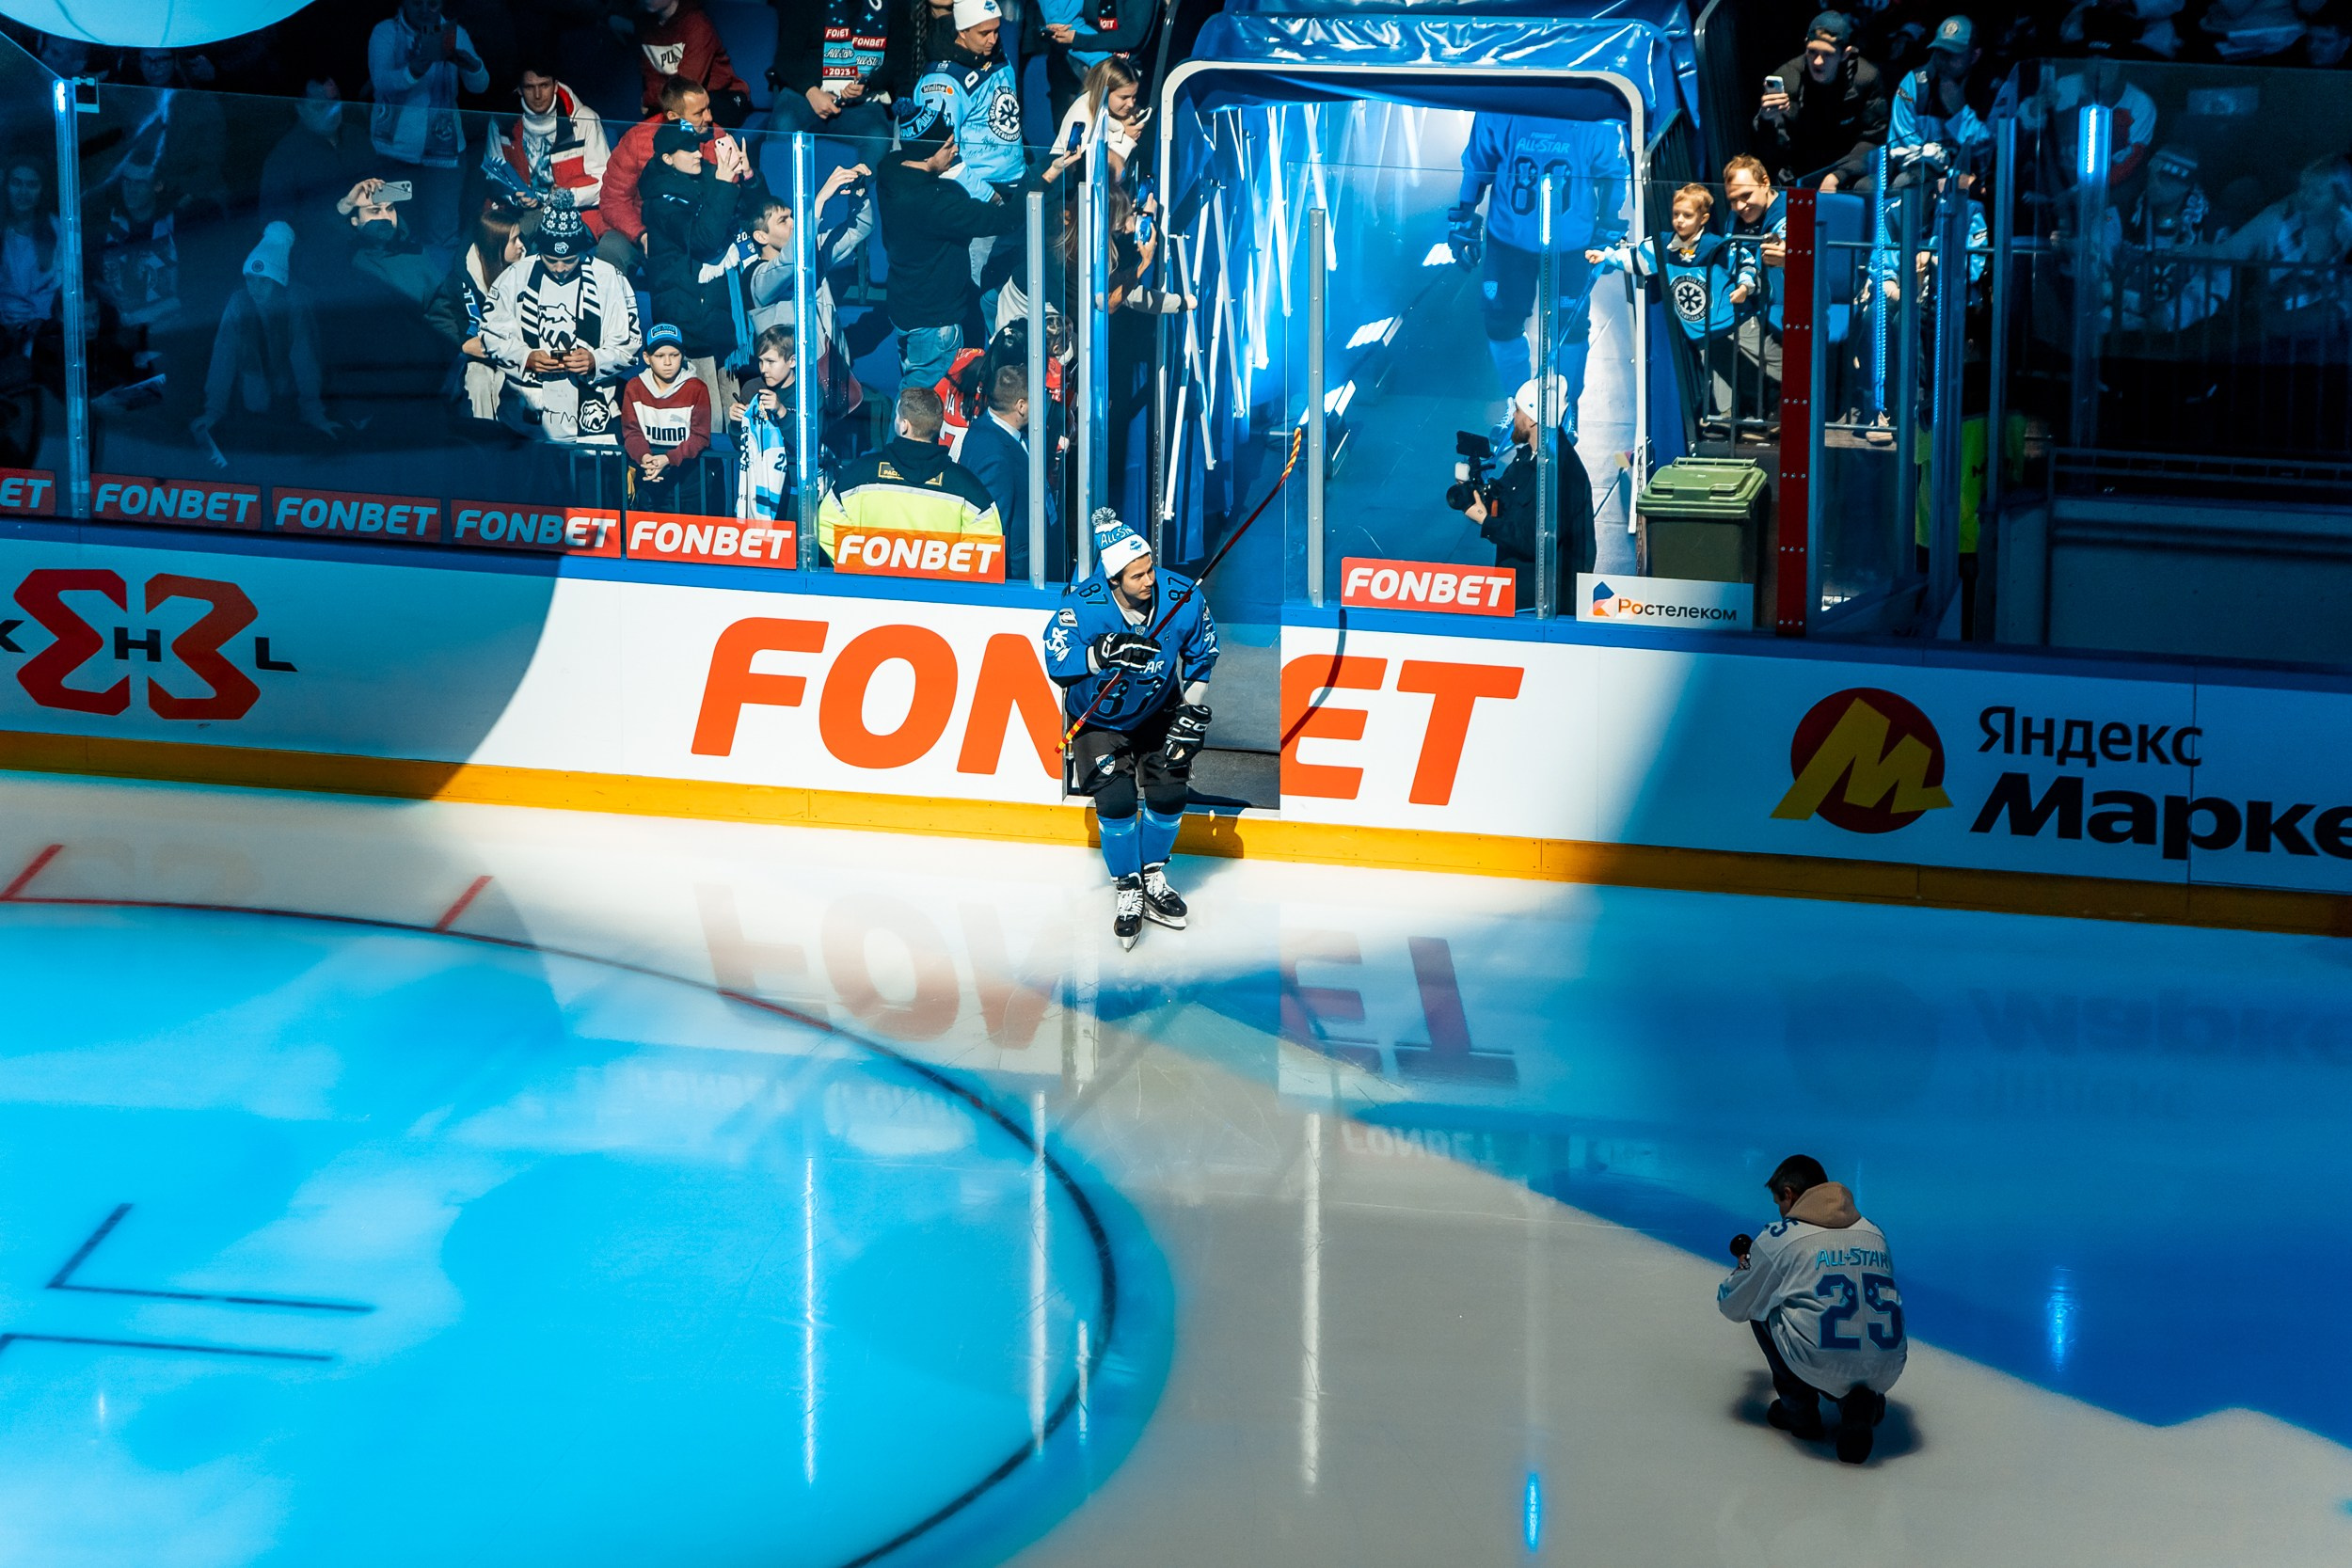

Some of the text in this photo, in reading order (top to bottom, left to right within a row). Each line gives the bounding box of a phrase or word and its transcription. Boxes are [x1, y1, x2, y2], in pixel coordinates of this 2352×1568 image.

[851, 37, 885, 48] FONBET
[0, 477, 53, 509] ET
[95, 482, 259, 524] FONBET
[275, 497, 438, 537] FONBET
[454, 510, 618, 550] FONBET
[629, 520, 791, 561] FONBET
[836, 534, 1002, 575] FONBET
[1344, 567, 1512, 609] FONBET
[1617, 597, 1738, 622] Ростелеком
[1090, 673, 1168, 720] 87
[1978, 705, 2203, 769] Яндекс
[1970, 770, 2352, 860] Марке
[1816, 1272, 1903, 1350] 25
